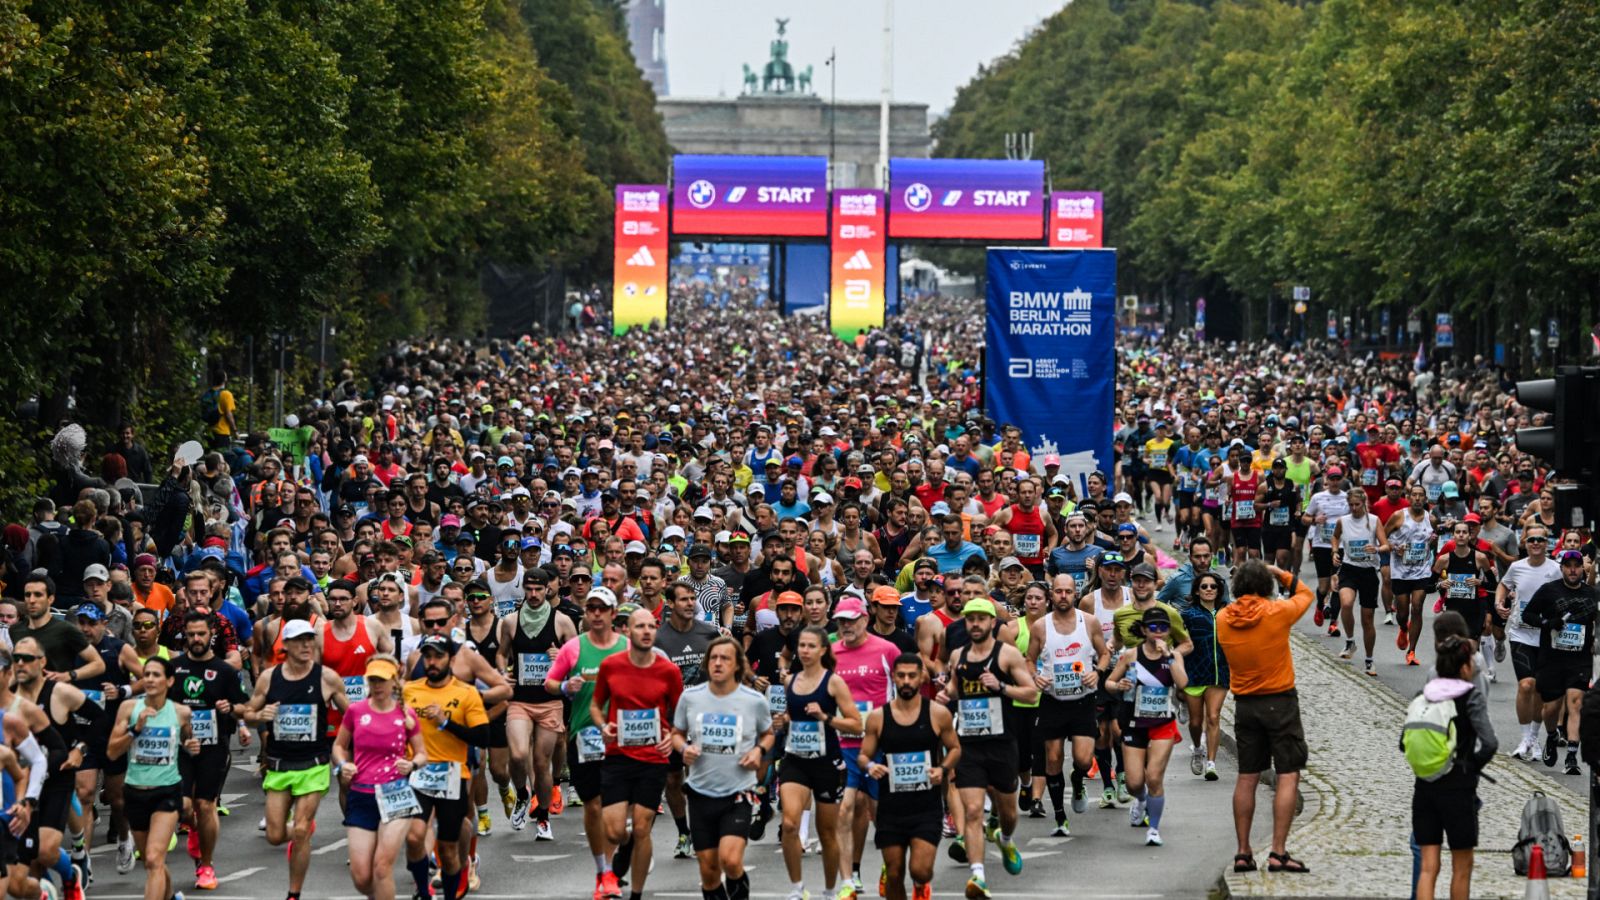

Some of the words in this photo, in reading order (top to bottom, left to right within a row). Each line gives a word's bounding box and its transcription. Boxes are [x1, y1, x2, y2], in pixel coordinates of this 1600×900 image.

[757, 187, 815, 203] START
[973, 190, 1031, 206] START
[1009, 291, 1060, 309] BMW
[1009, 310, 1060, 321] BERLIN
[1009, 323, 1091, 335] MARATHON
[1558, 632, 1579, 640] 69173
[525, 664, 549, 672] 20196
[1055, 672, 1080, 683] 37558
[1141, 696, 1167, 705] 39606
[280, 717, 309, 726] 40306
[625, 722, 653, 731] 26601
[703, 727, 734, 737] 26833
[791, 734, 817, 743] 26604
[138, 739, 168, 749] 69930
[895, 766, 924, 776] 53267
[386, 790, 413, 804] 19158
